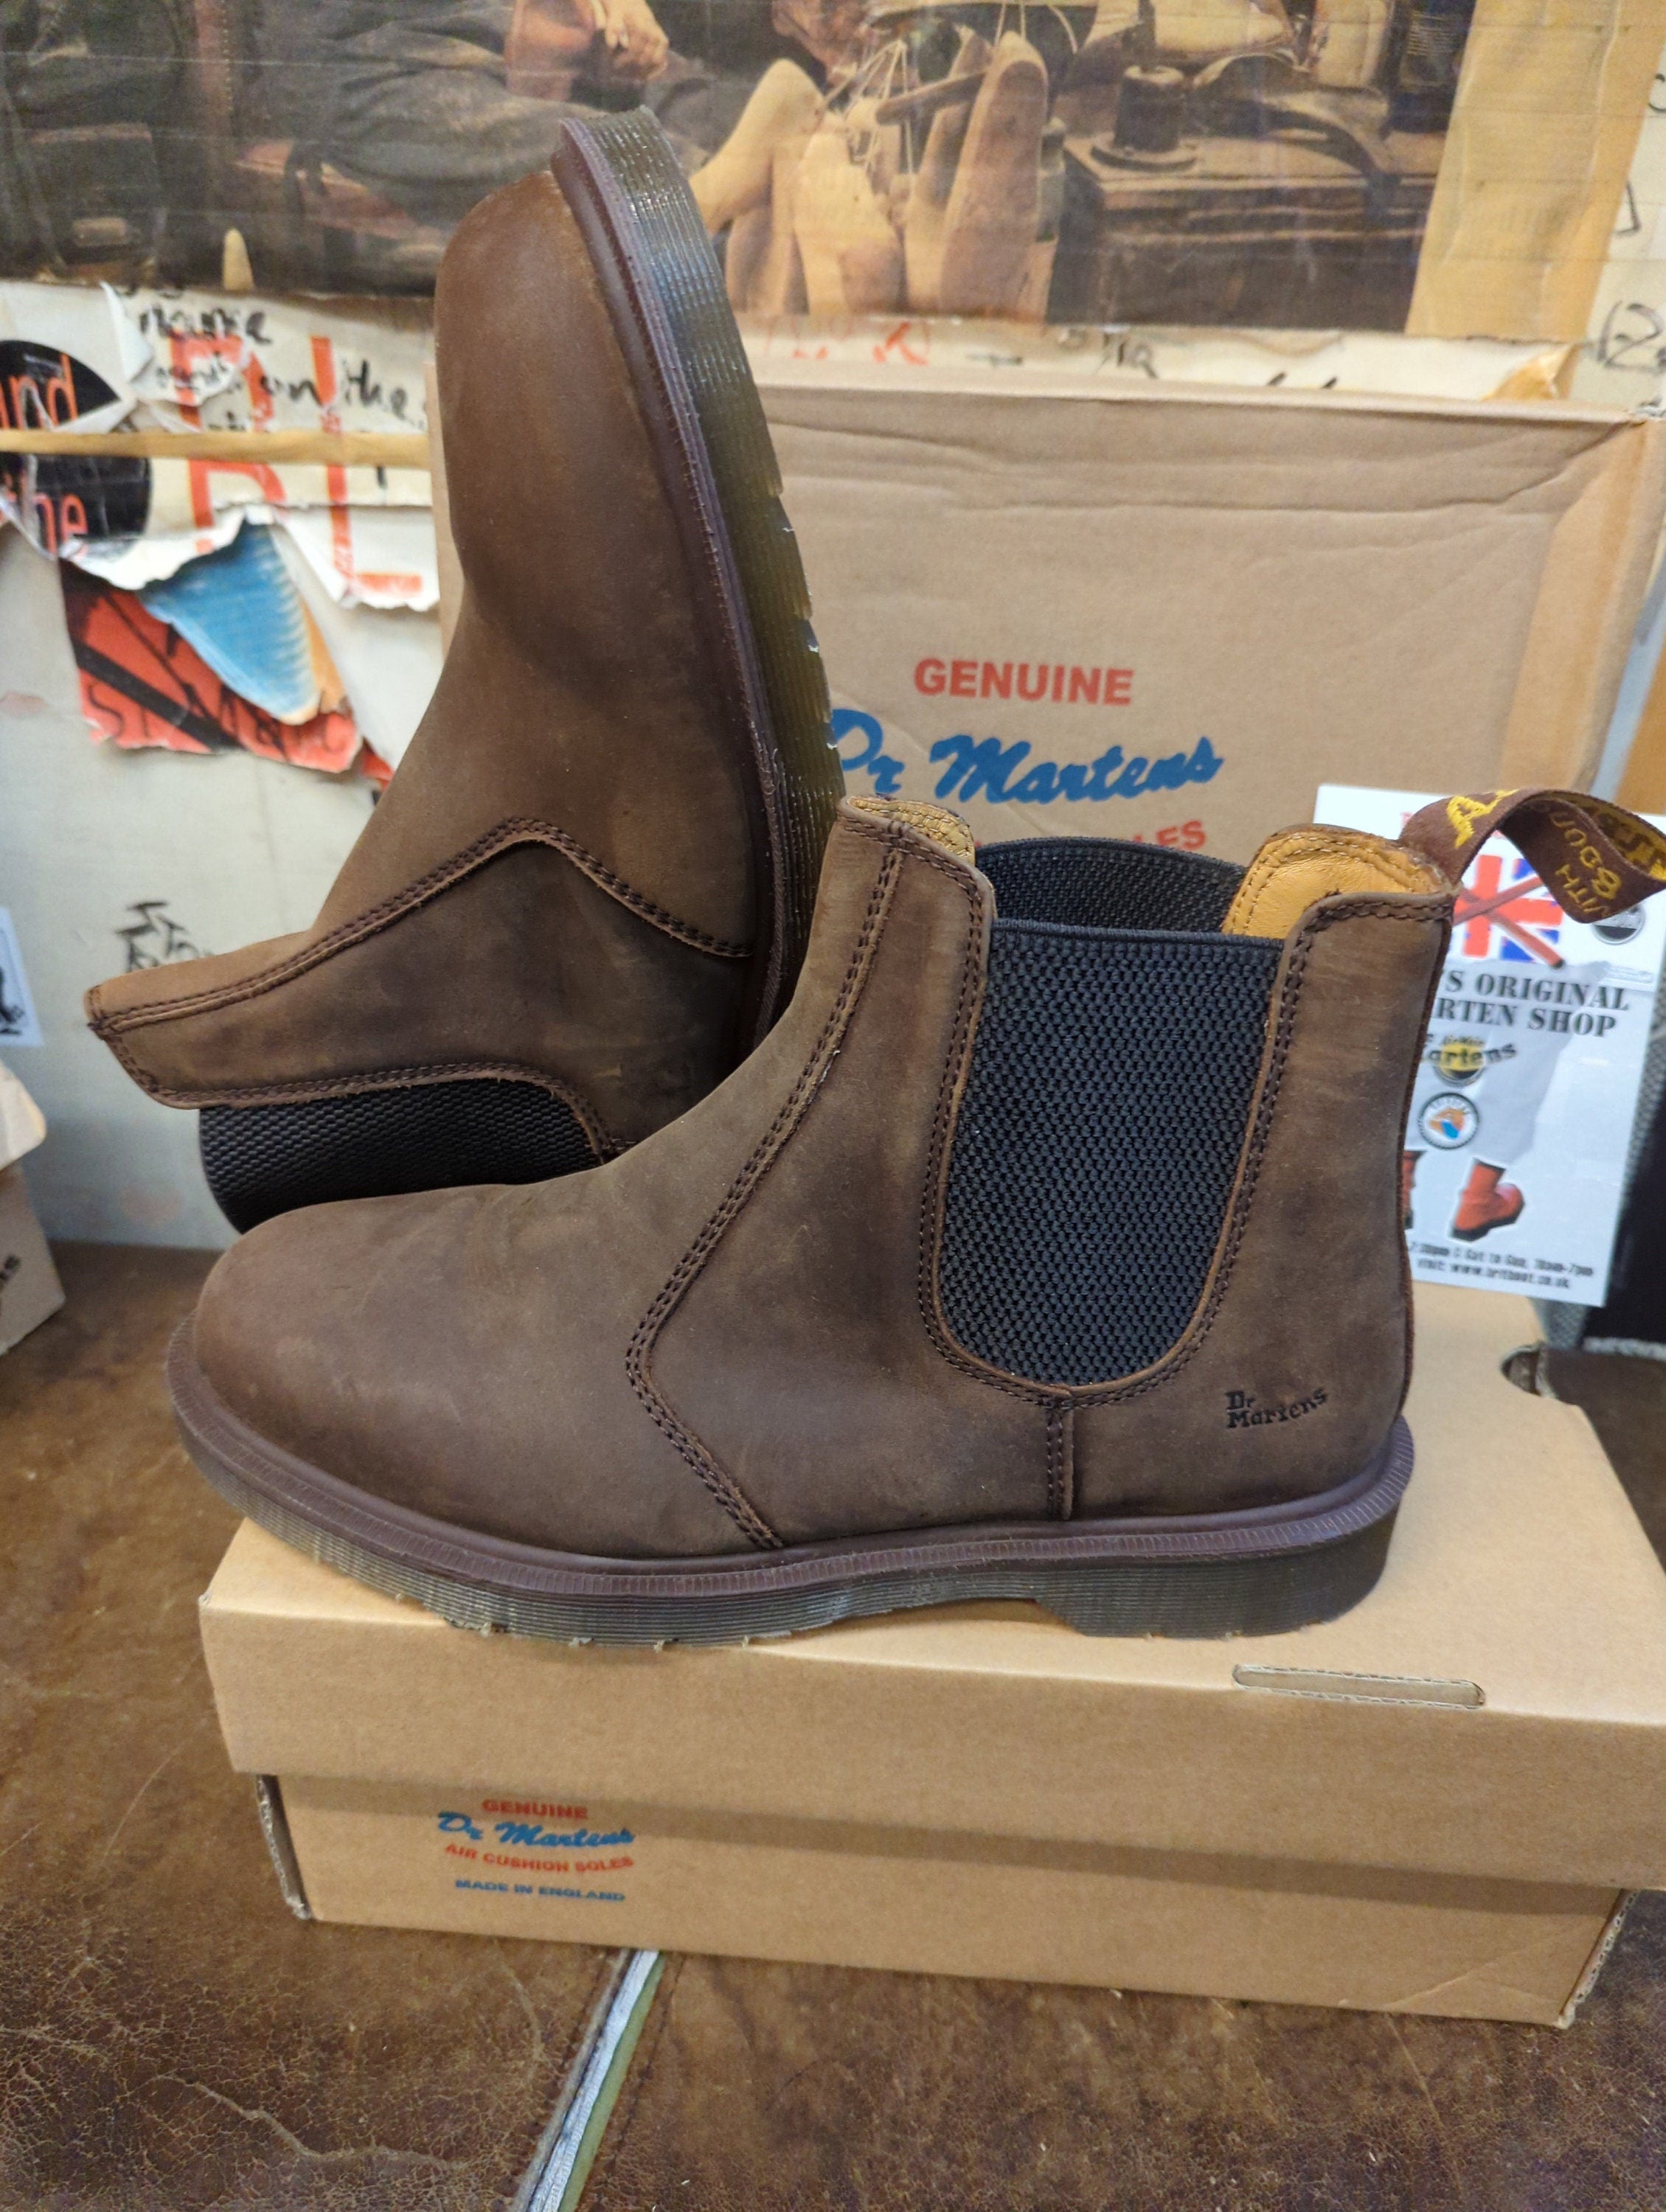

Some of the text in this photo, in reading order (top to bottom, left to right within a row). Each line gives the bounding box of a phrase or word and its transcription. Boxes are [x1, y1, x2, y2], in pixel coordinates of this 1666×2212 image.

[914, 658, 1134, 706] GENUINE
[831, 709, 1224, 804] Dr Martens
[1445, 970, 1630, 1011] S ORIGINAL
[1436, 997, 1617, 1037] RTEN SHOP
[1428, 1043, 1517, 1066] artens
[1226, 1388, 1328, 1428] Martens
[482, 1799, 589, 1819] GENUINE
[438, 1811, 636, 1847] Dr Martens
[445, 1843, 634, 1873] AIR CUSHION SOLES
[455, 1879, 625, 1902] MADE IN ENGLAND
